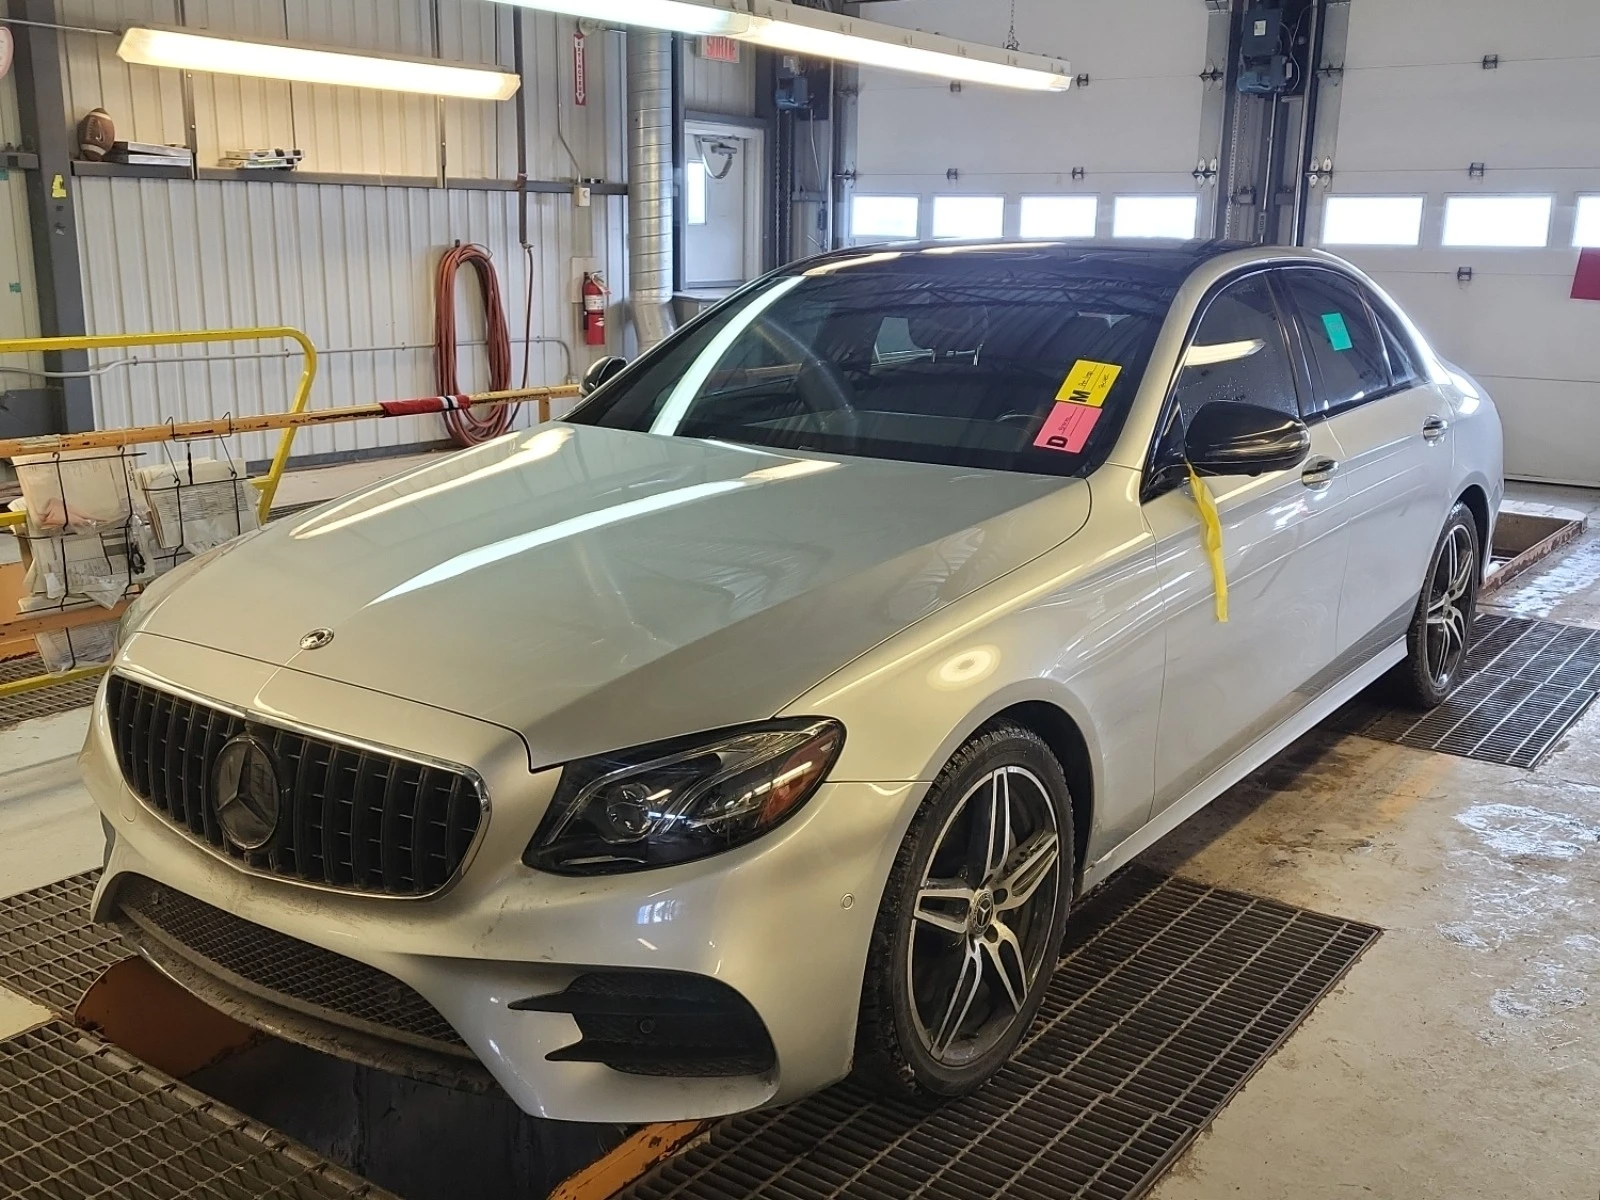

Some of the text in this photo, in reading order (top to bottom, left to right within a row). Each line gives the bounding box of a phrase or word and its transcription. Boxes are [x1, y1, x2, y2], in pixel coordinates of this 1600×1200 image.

[707, 36, 736, 61] SORTIE
[1069, 389, 1091, 402] M
[1046, 435, 1068, 448] D
